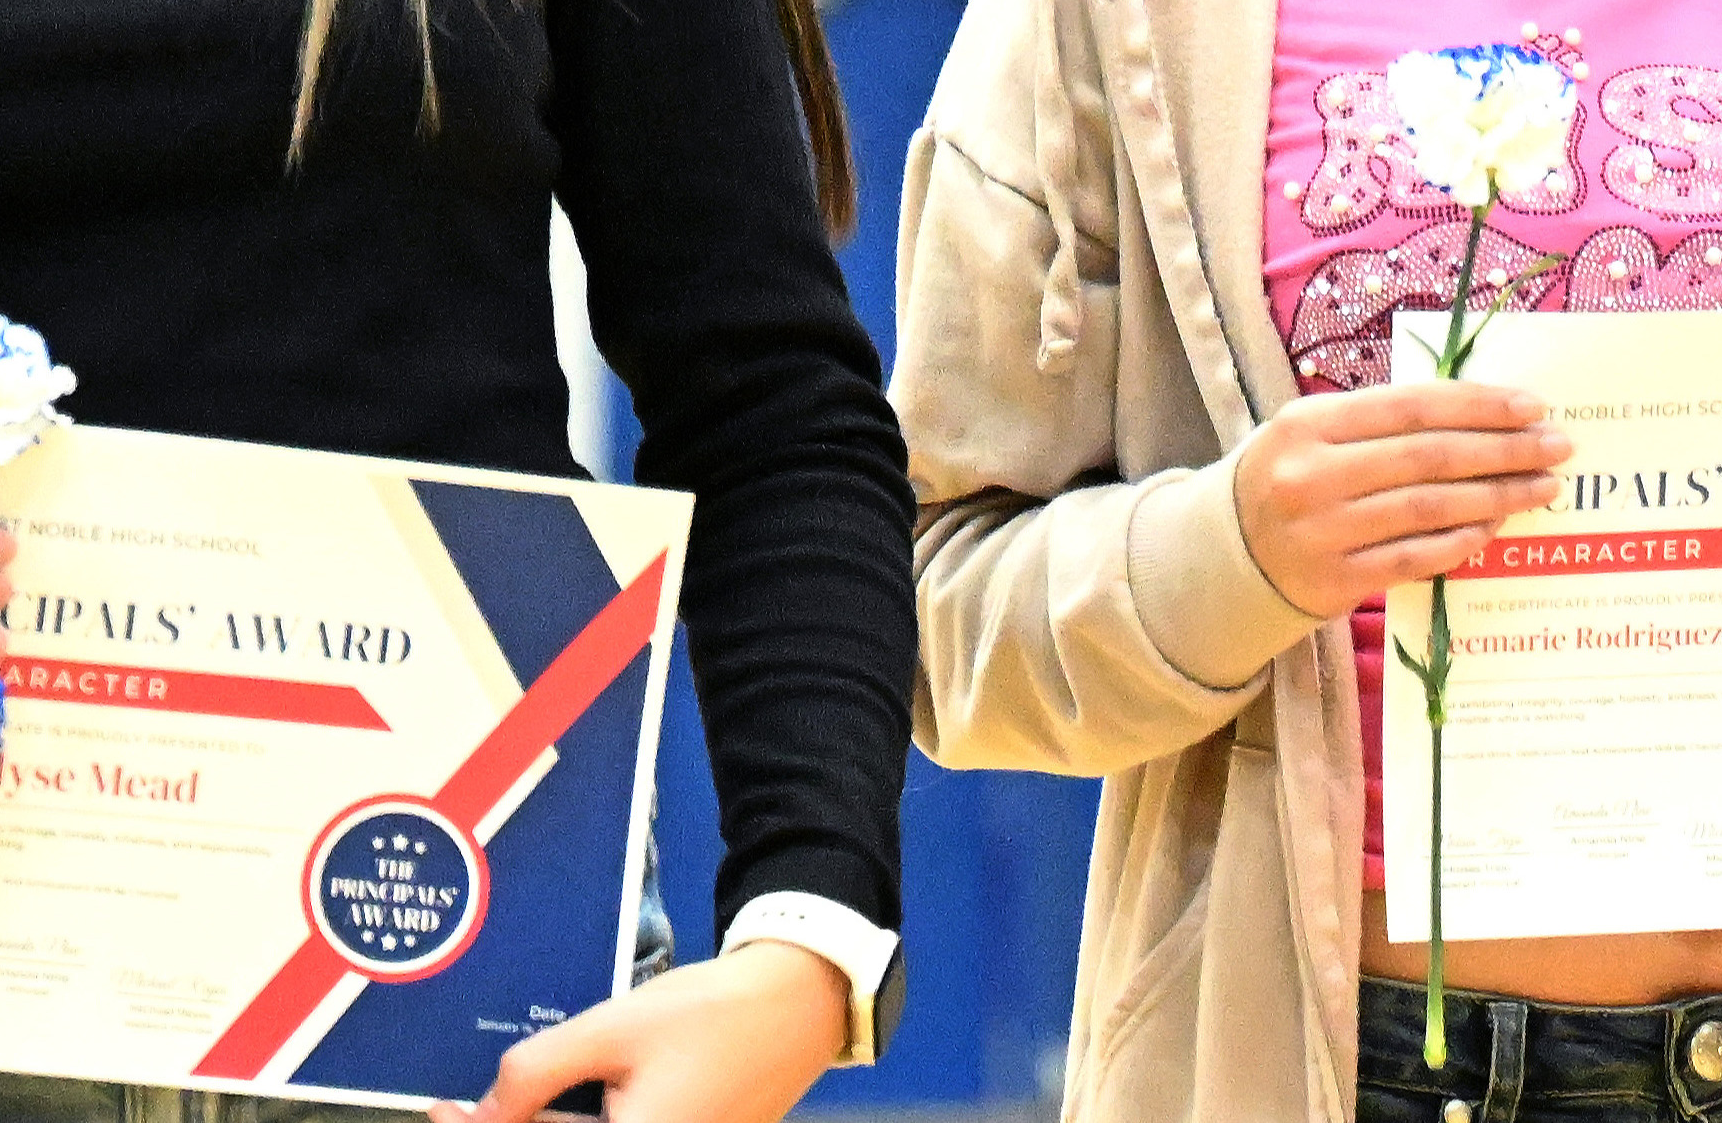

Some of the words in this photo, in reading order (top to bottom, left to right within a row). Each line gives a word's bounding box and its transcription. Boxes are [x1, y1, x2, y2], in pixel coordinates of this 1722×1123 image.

[1563, 402, 1632, 422] NOBLE
[1640, 400, 1689, 418] HIGH
[28, 520, 103, 544] NOBLE
[110, 526, 165, 548] HIGH
[171, 530, 263, 558] SCHOOL
[1502, 537, 1701, 568] CHARACTER
[1613, 592, 1682, 607] PROUDLY
[212, 610, 413, 666] AWARD
[3, 663, 170, 701] ARACTER
[89, 761, 199, 804] Mead
[376, 857, 415, 880] THE
[344, 902, 441, 933] AWARD
